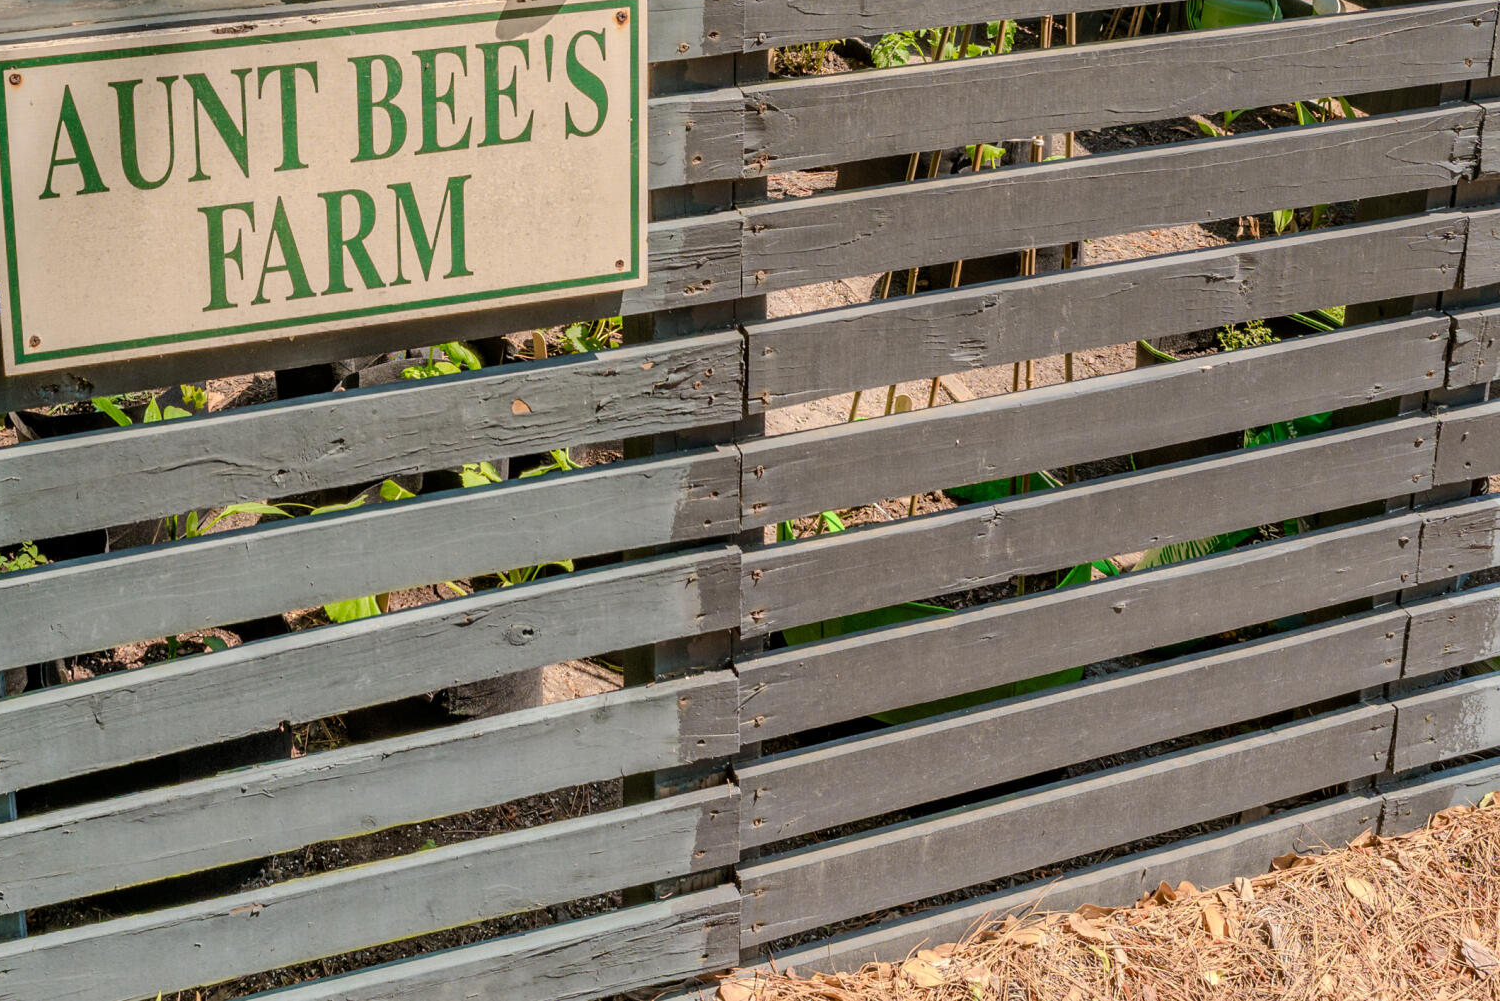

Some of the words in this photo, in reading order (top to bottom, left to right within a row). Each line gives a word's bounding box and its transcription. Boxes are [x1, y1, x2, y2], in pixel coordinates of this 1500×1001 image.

[39, 60, 319, 200] AUNT
[348, 28, 609, 163] BEE'S
[197, 174, 474, 312] FARM
